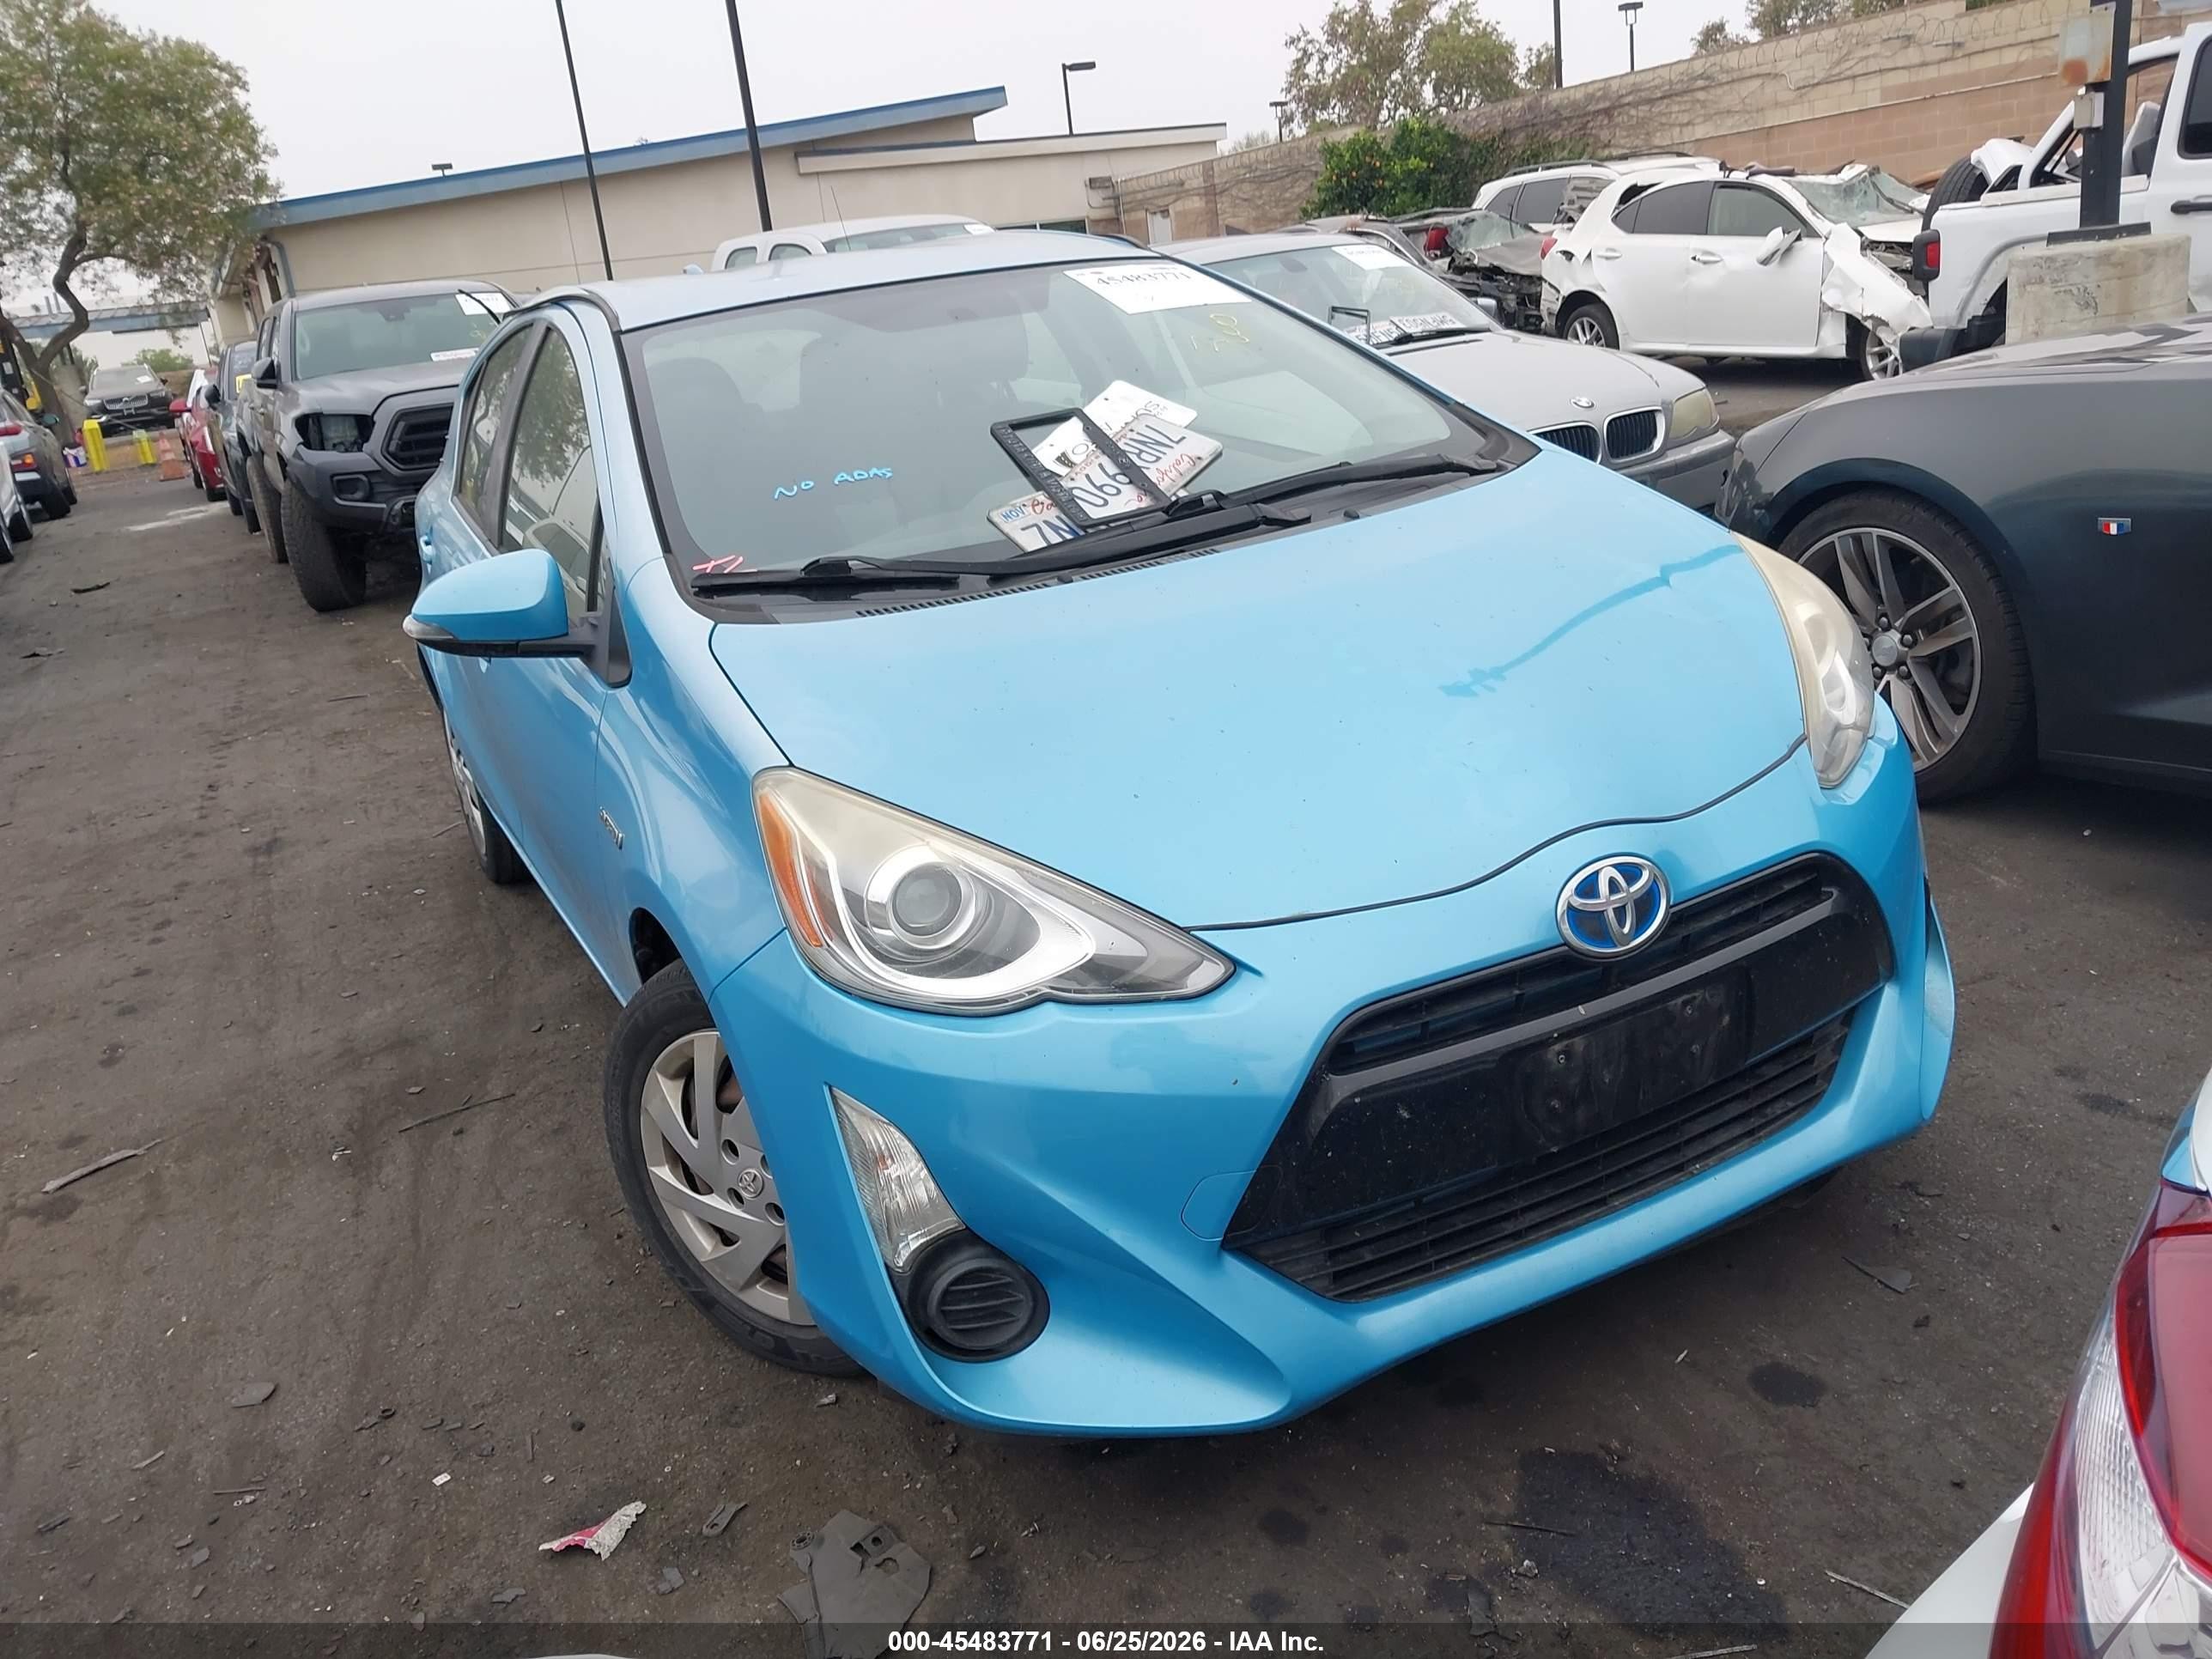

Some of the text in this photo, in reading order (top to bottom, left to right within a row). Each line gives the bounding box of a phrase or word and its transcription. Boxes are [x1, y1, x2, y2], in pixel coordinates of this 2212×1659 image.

[1097, 271, 1192, 286] 45483771
[774, 466, 894, 500] NO ADAS
[1000, 504, 1025, 522] NOV
